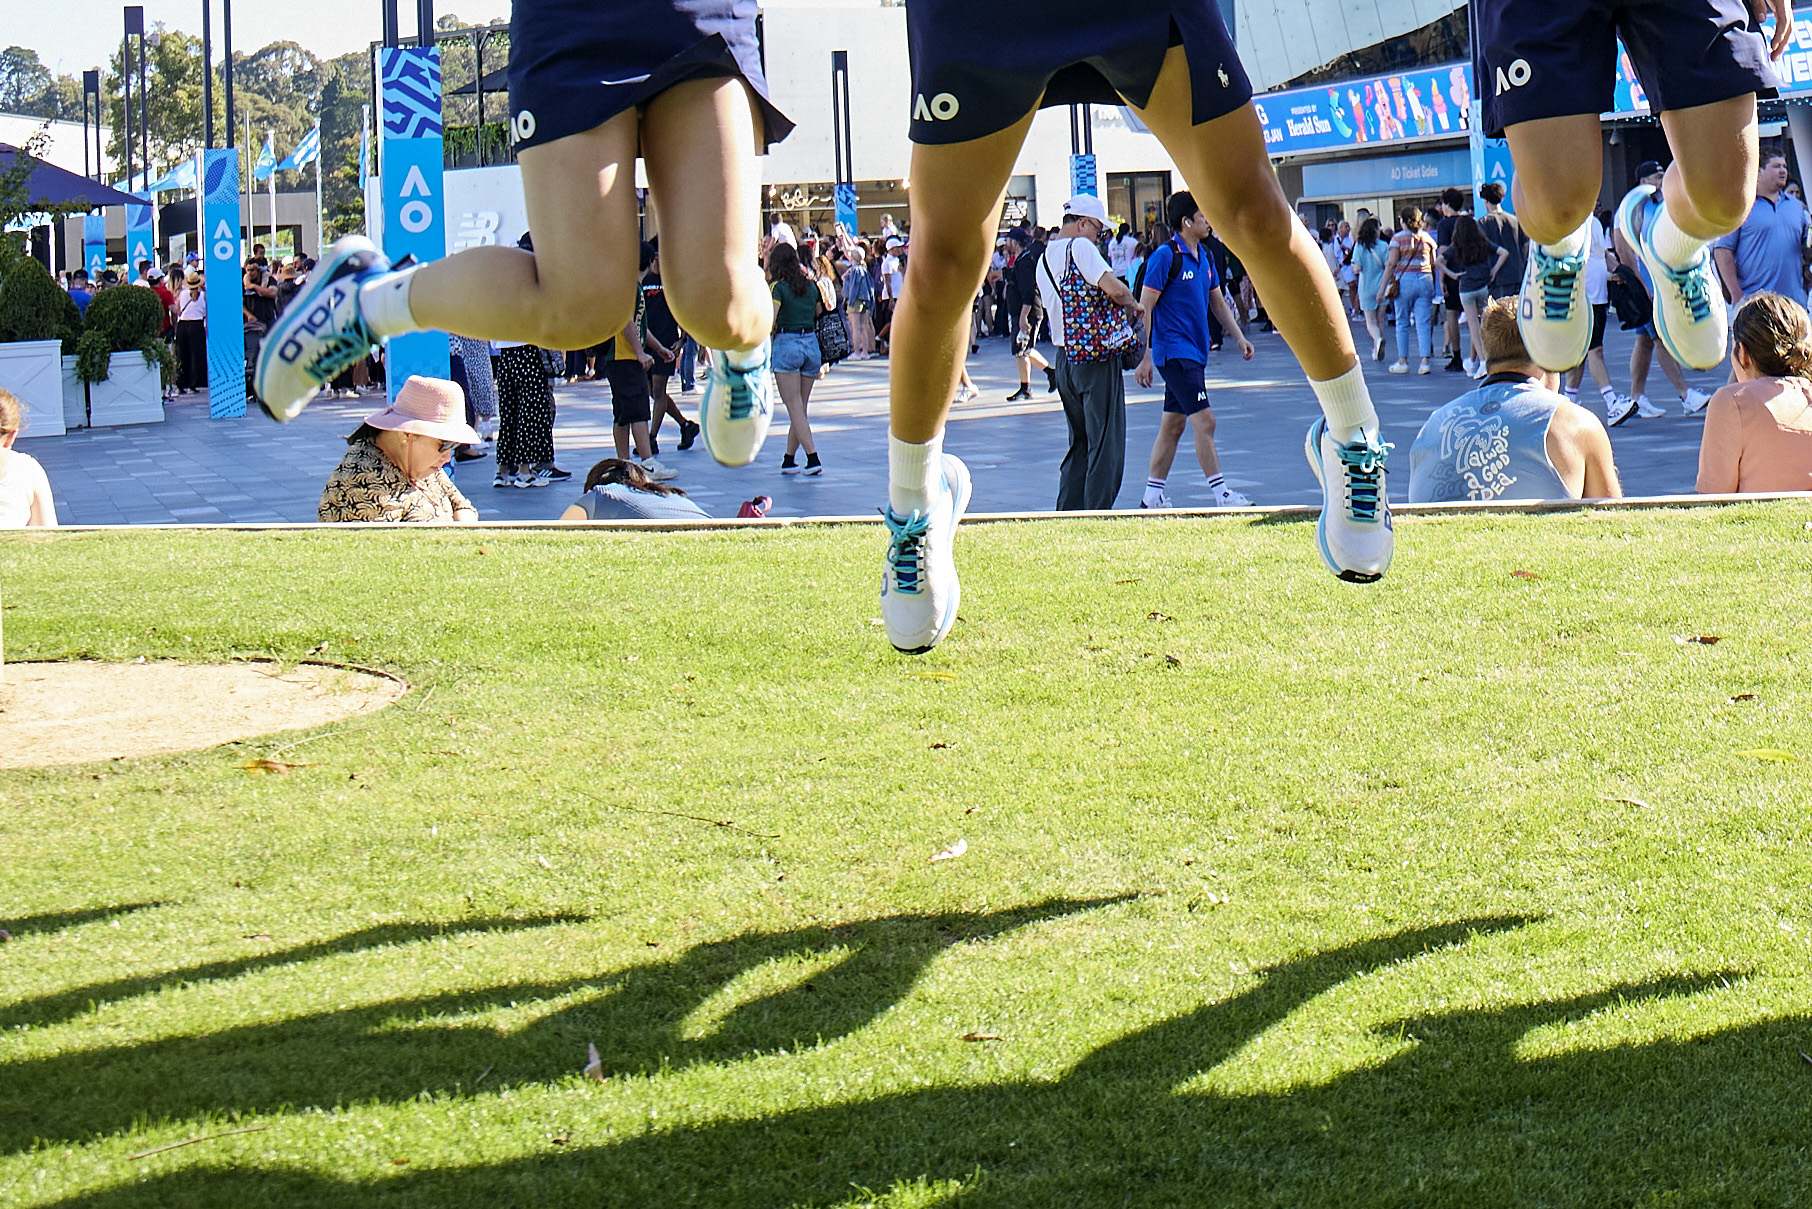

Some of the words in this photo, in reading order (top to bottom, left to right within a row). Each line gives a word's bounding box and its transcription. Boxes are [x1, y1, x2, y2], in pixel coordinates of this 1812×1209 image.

[1496, 58, 1532, 97] AO
[912, 93, 959, 122] AO
[511, 109, 536, 147] AO
[1271, 128, 1284, 142] JAN
[1286, 116, 1313, 137] Herald
[1313, 117, 1332, 134] Sun
[1391, 168, 1401, 180] AO
[1402, 166, 1421, 179] Ticket
[1421, 165, 1439, 178] Sales
[399, 165, 433, 233] AO
[213, 219, 234, 261] AO
[1182, 271, 1194, 280] AO
[1463, 472, 1485, 490] a
